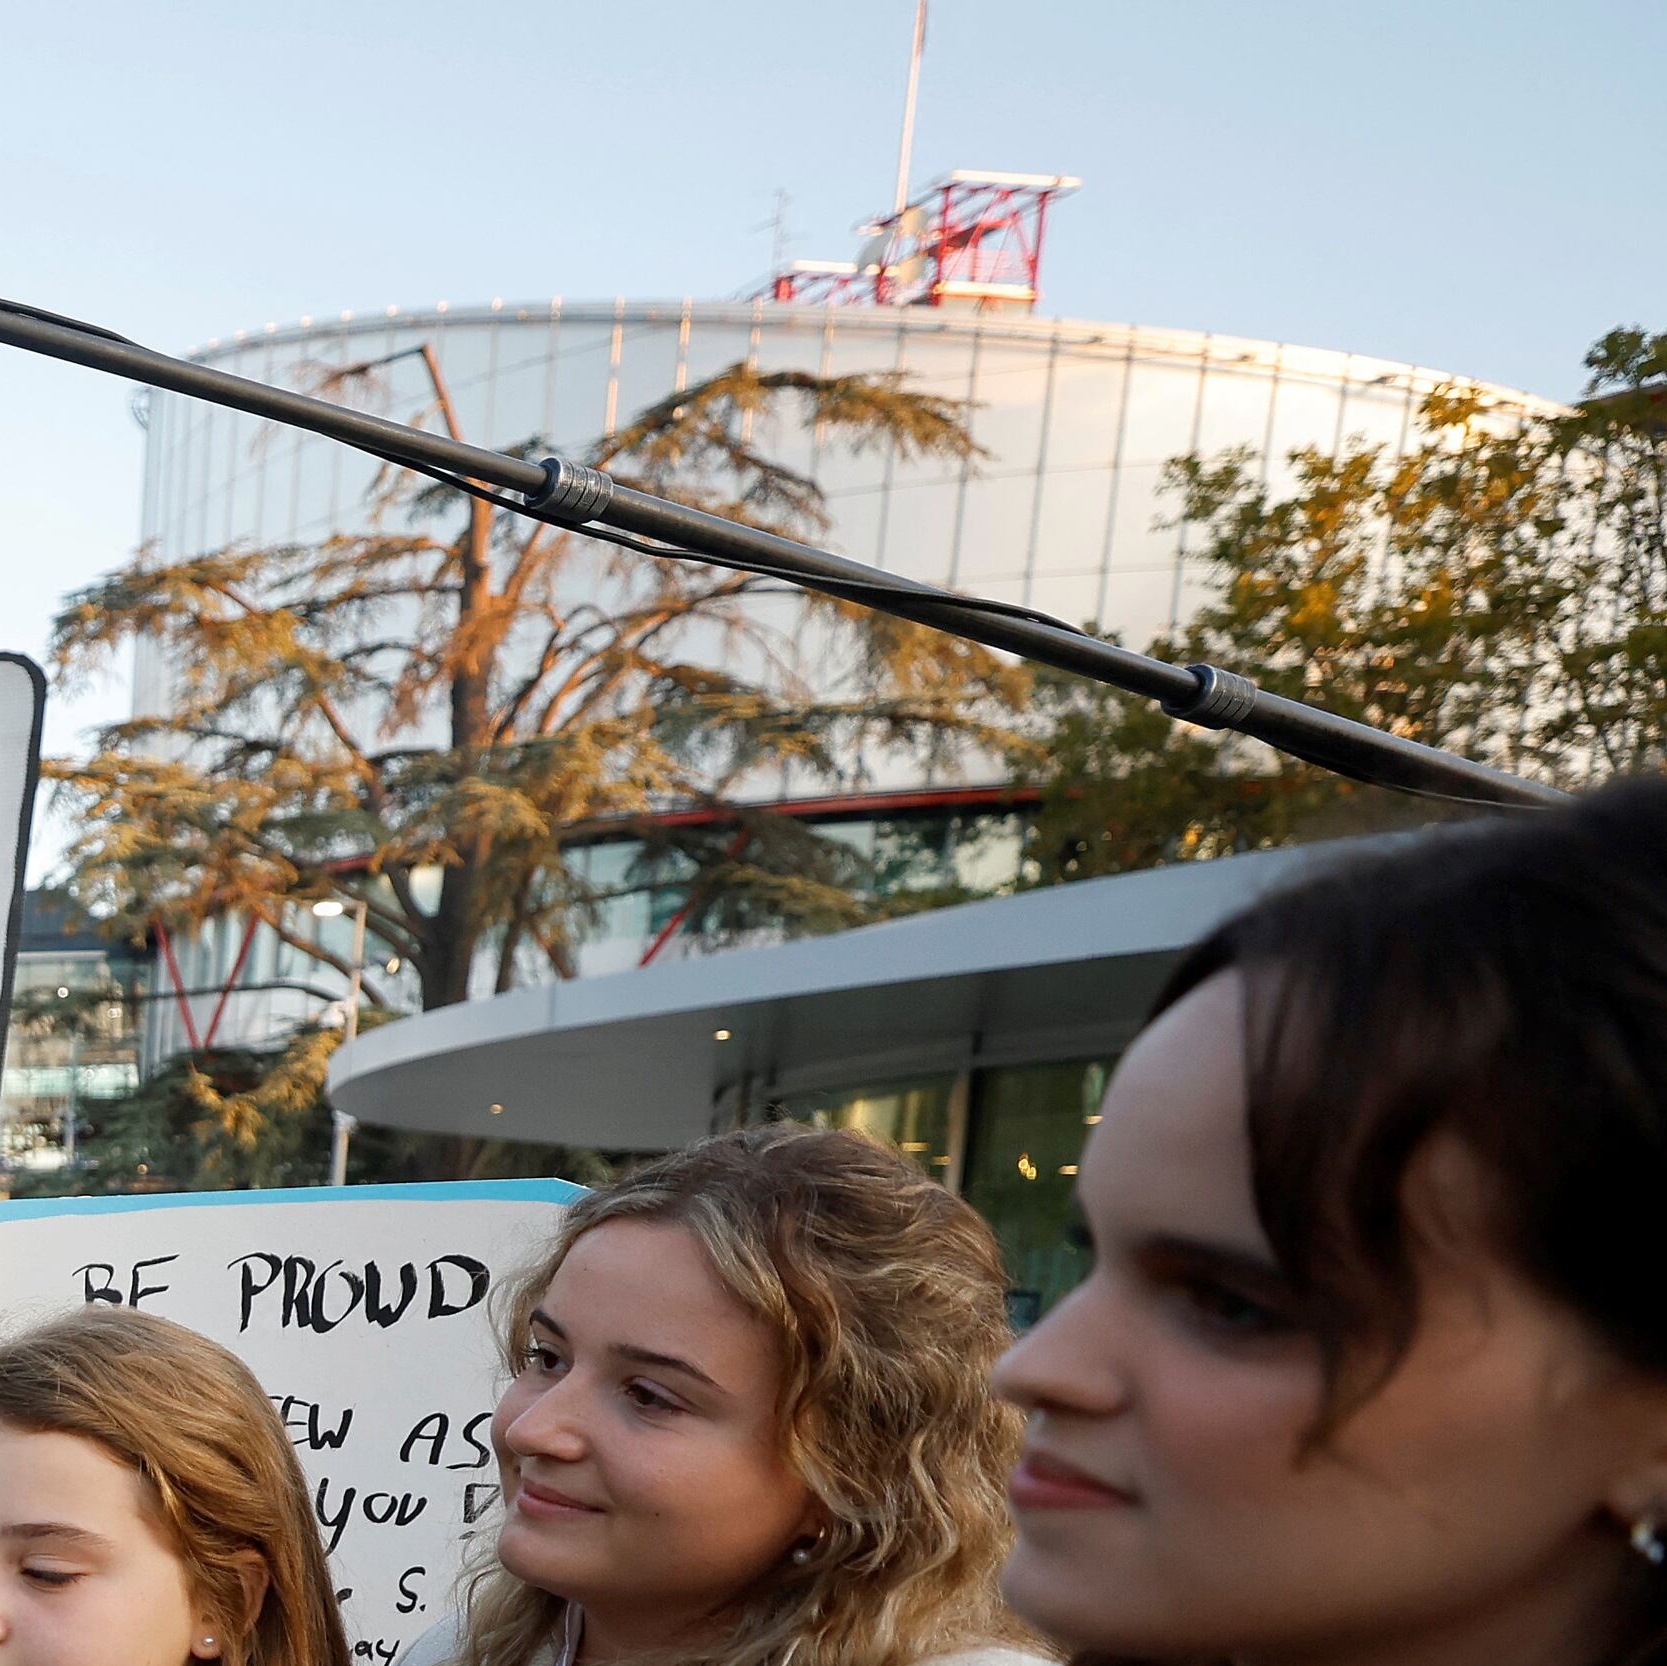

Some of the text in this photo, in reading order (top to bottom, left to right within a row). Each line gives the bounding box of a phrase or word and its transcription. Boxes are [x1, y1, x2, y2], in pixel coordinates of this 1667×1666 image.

[227, 1252, 491, 1334] PROUD
[267, 1395, 496, 1471] EW AS
